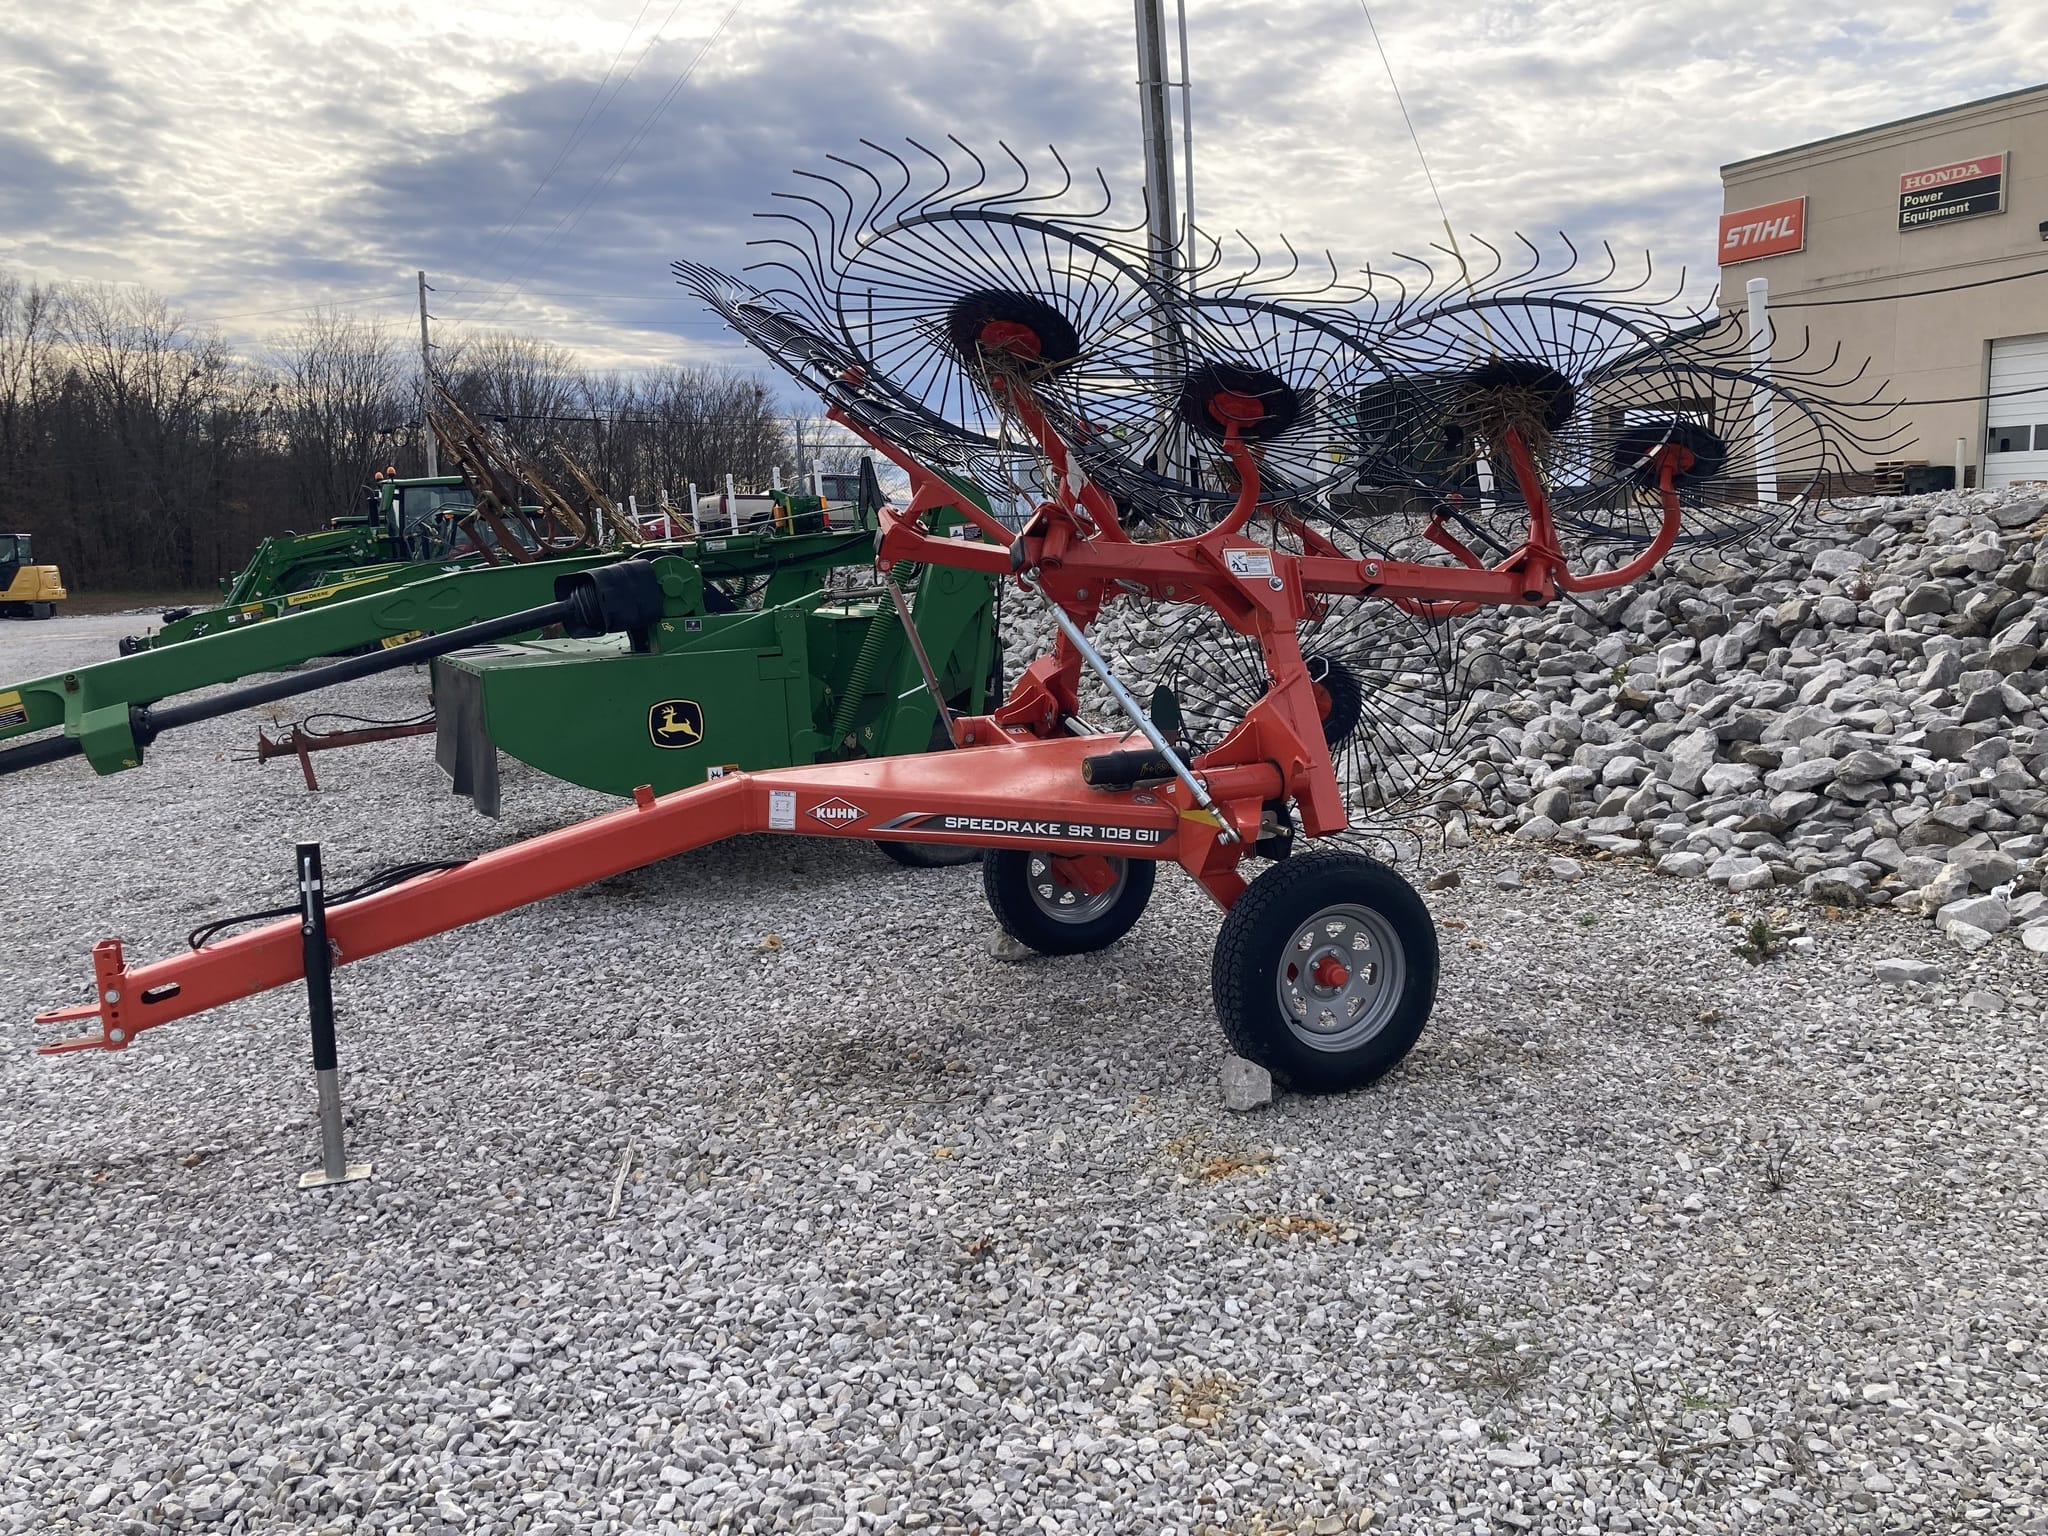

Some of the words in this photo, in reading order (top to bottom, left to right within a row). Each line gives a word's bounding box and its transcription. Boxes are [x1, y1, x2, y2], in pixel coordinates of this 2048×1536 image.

[1905, 164, 1982, 189] HONDA
[1903, 191, 1943, 207] Power
[1903, 201, 1970, 223] Equipment
[1723, 215, 1796, 249] STIHL
[309, 590, 329, 600] DEERE
[816, 807, 858, 819] KUHN
[944, 816, 1061, 836] SPEEDRAKE
[1068, 825, 1094, 838] SR
[1099, 826, 1131, 840] 108
[1135, 829, 1159, 842] GII
